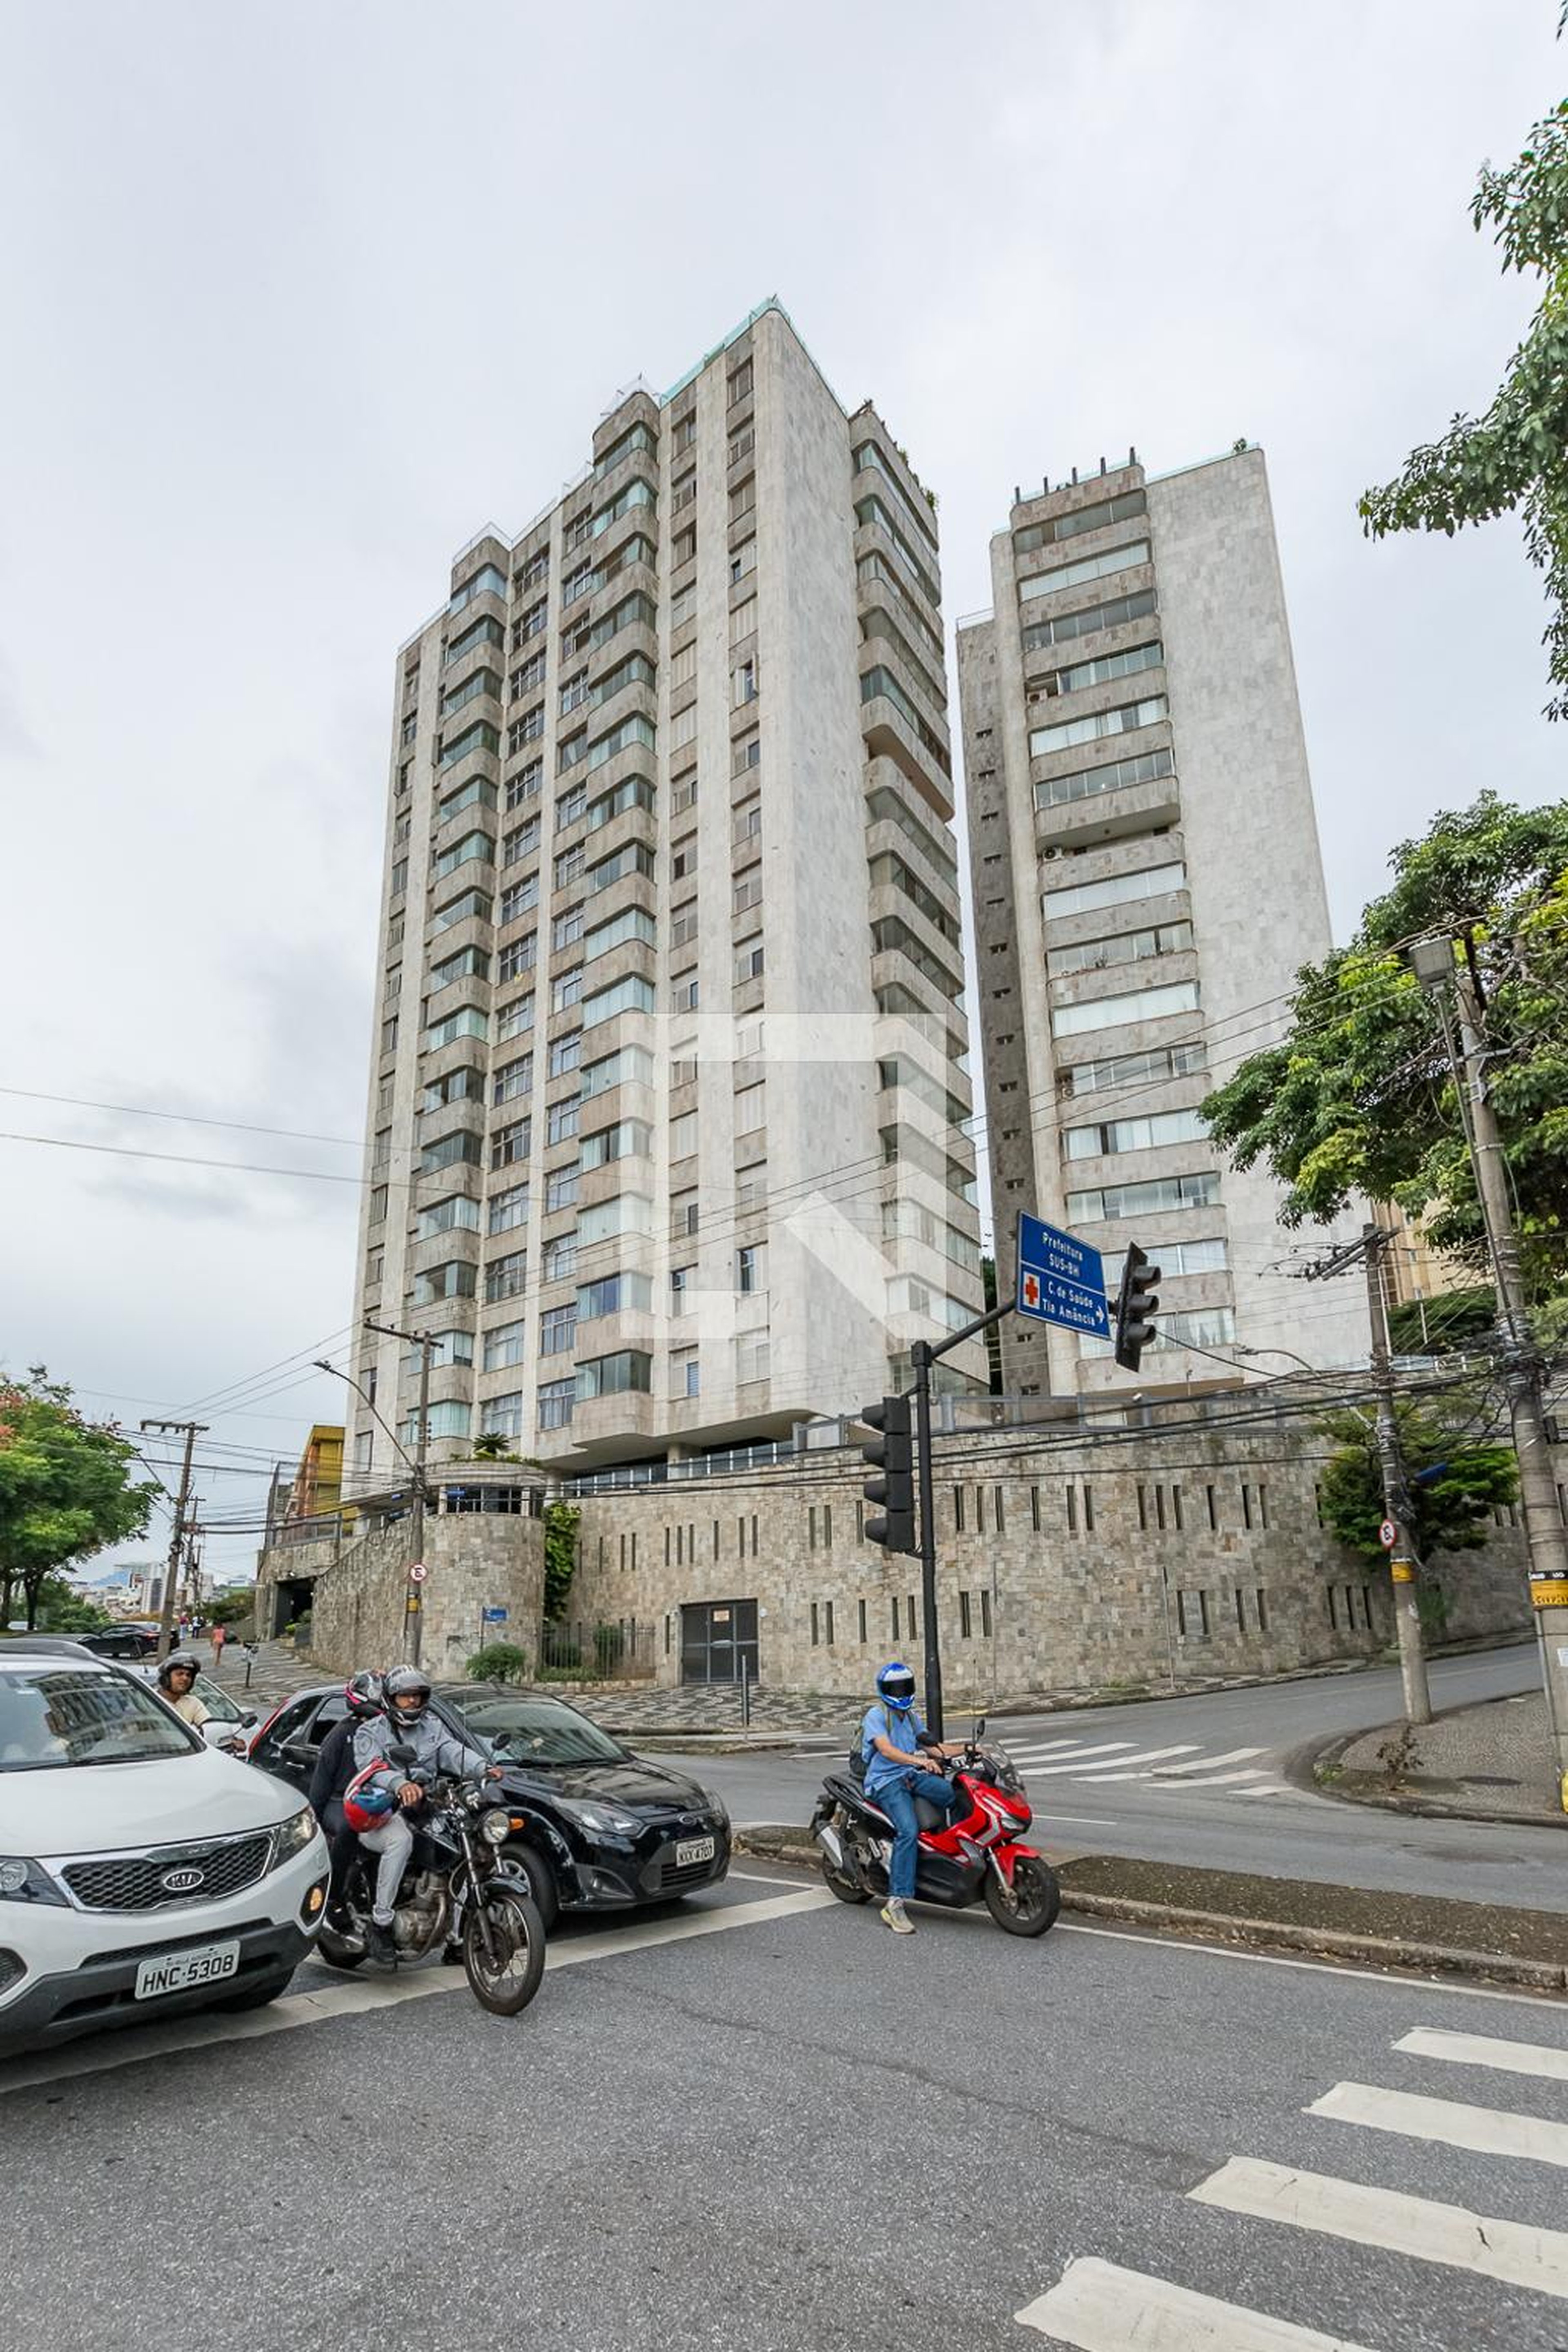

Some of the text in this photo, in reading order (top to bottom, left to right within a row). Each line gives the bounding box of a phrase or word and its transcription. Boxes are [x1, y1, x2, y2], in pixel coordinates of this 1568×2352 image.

[1042, 1232, 1082, 1261] Prefeitura
[1049, 1253, 1080, 1277] SUS-BH
[1042, 1298, 1055, 1314] Tia
[1057, 1286, 1067, 1299] de
[1069, 1289, 1093, 1308] Saúde
